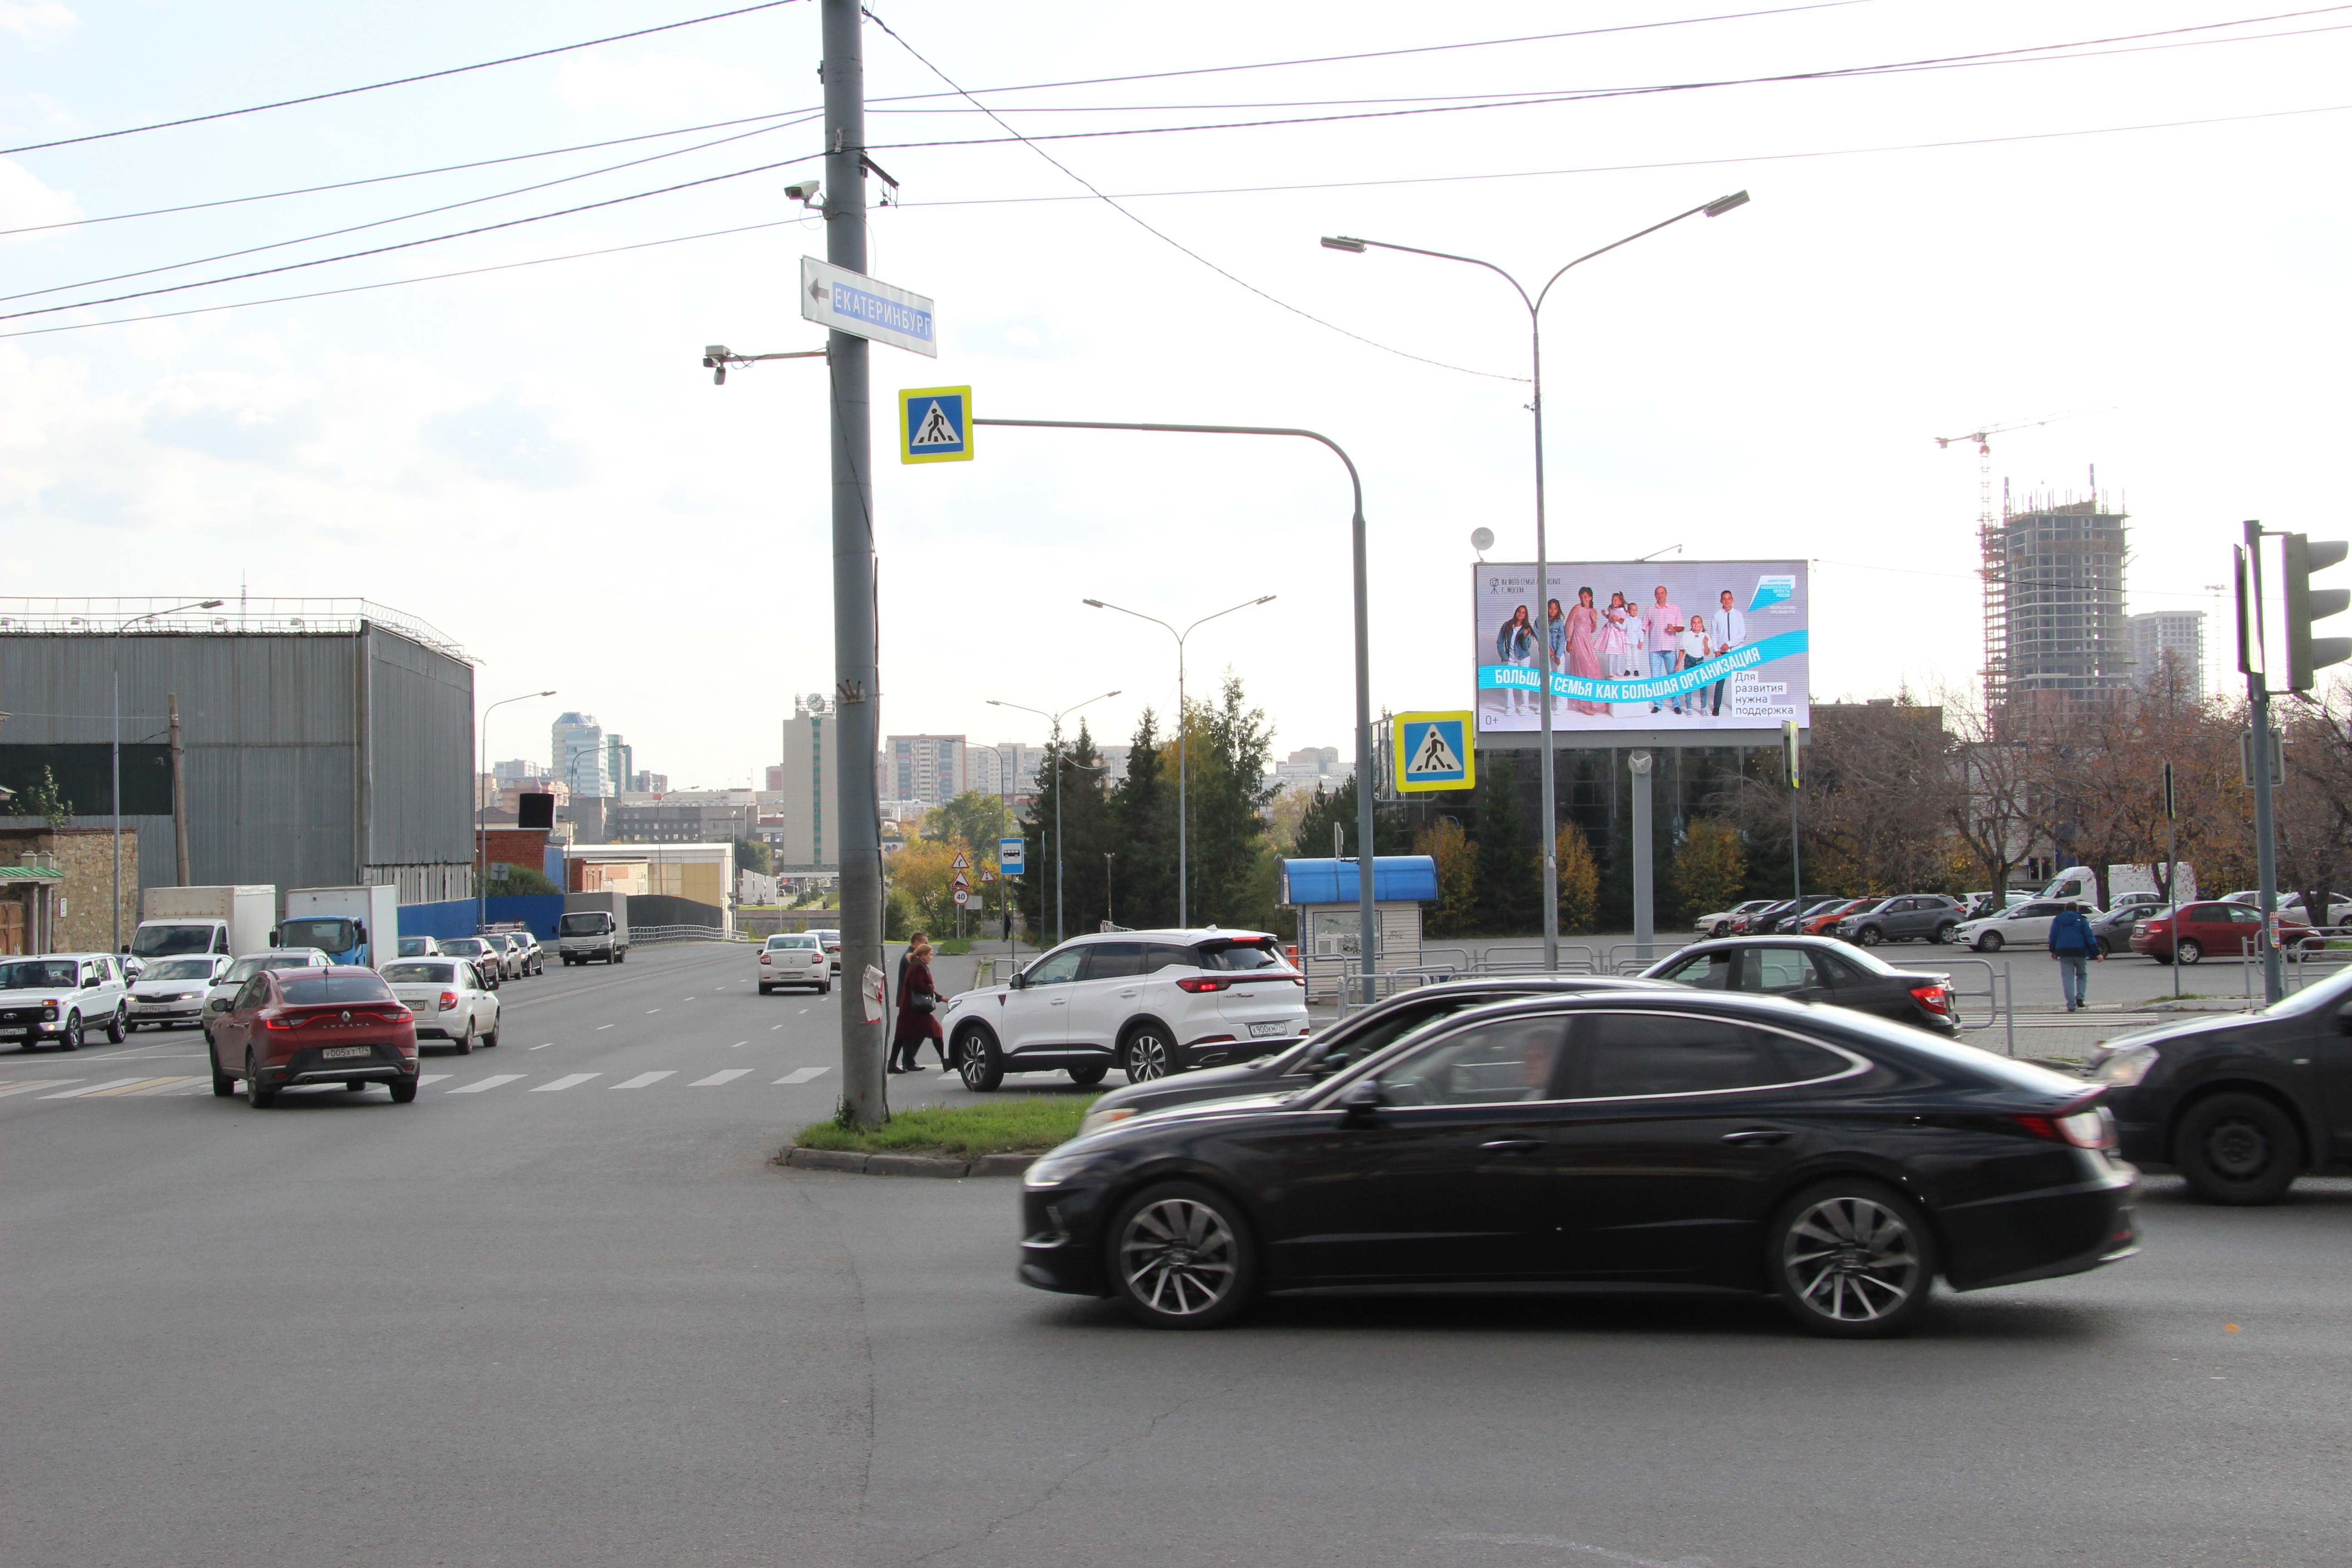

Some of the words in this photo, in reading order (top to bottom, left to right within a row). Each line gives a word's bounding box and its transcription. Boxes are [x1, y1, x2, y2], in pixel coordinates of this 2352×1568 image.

[834, 287, 931, 336] ЕКАТЕРИНБУРГ
[1495, 669, 1551, 687] БОЛЬШ
[1554, 677, 1593, 696] СЕМЬЯ
[1596, 683, 1619, 699] КАК
[1622, 678, 1679, 699] БОЛЬШАЯ
[1679, 647, 1761, 690] ОРГАНИЗАЦИЯ
[1735, 672, 1755, 683] Для
[1735, 685, 1783, 694] развития
[1735, 696, 1768, 705] нужна
[1736, 707, 1793, 716] поддержка
[1485, 715, 1499, 725] 0+
